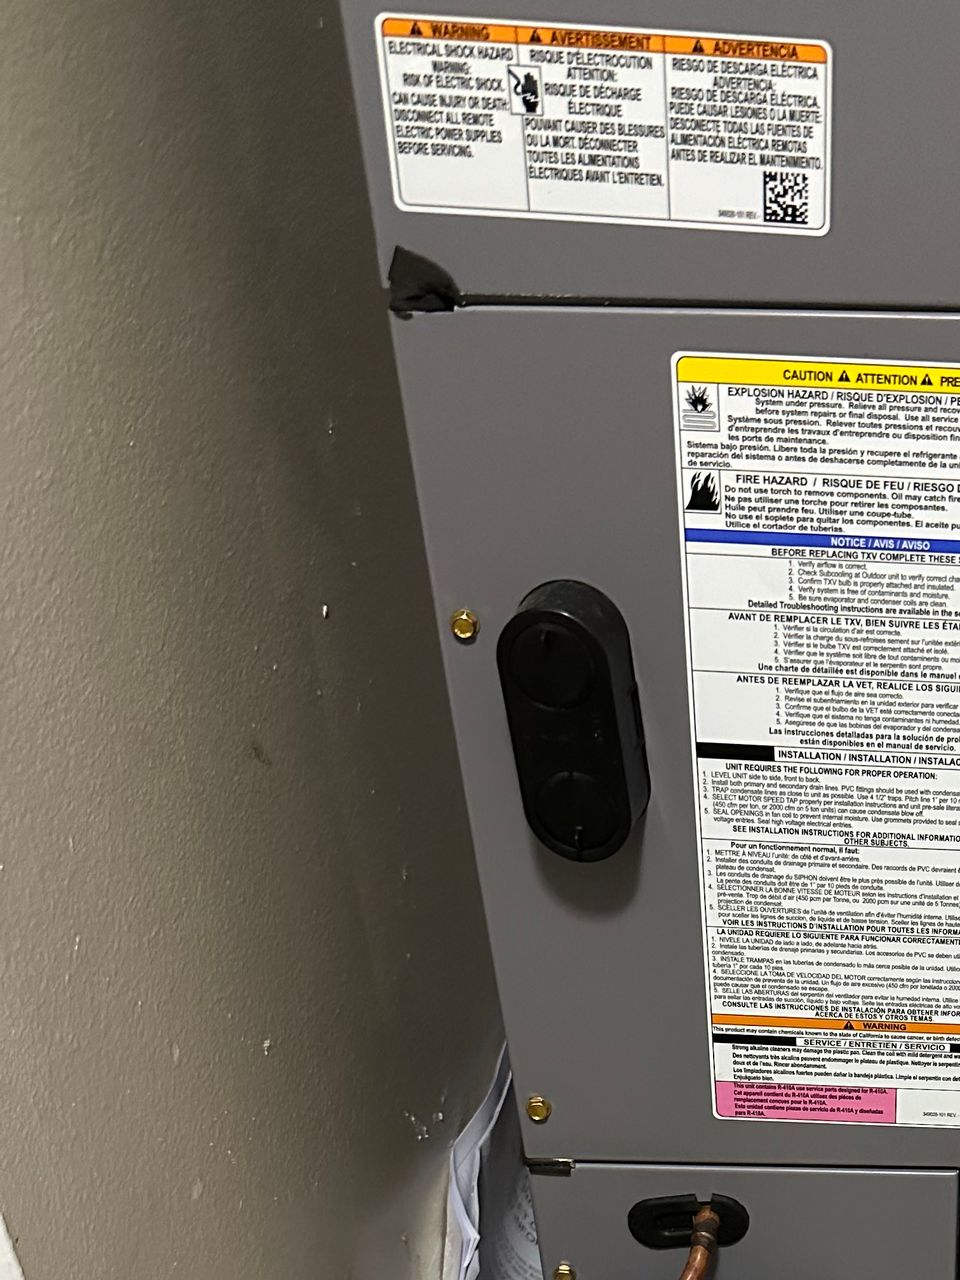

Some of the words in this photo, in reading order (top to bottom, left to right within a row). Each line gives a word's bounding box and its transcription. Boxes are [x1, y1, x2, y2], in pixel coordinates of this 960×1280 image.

[431, 23, 490, 40] WARNING
[550, 31, 649, 50] AVERTISSEMENT
[387, 40, 441, 56] ELECTRICAL
[444, 44, 475, 58] SHOCK
[477, 46, 513, 61] HAZARD
[529, 49, 564, 64] RISQUE
[566, 49, 652, 69] D'ÉLECTROCUTION
[713, 42, 797, 60] ADVERTENCIA
[566, 67, 617, 82] ATTENTION:
[672, 58, 704, 72] RIESGO
[706, 60, 718, 73] DE
[720, 61, 767, 76] DESCARGA
[770, 61, 817, 79] ELÉCTRICA
[402, 72, 421, 86] RISK
[422, 74, 433, 87] OF
[434, 74, 473, 89] ELECTRIC
[475, 77, 503, 91] SHOCK.
[712, 76, 776, 91] ADVERTENCIA:
[391, 91, 409, 104] CAN
[410, 93, 437, 106] CAUSE
[438, 94, 466, 108] INJURY
[468, 96, 480, 109] OR
[481, 97, 509, 111] DEATH:
[543, 83, 576, 97] RISQUE
[578, 85, 590, 98] DE
[592, 83, 641, 101] DÉCHARGE
[671, 87, 704, 100] RIESGO
[705, 89, 717, 101] DE
[719, 90, 767, 104] DESCARGA
[770, 91, 820, 108] ELÉCTRICA.
[393, 108, 443, 123] DISCONNECT
[445, 111, 459, 124] ALL
[461, 112, 494, 126] REMOTE
[568, 99, 622, 118] ÉLECTRIQUE
[668, 102, 694, 114] PUEDE
[696, 104, 728, 117] CAUSAR
[730, 106, 767, 119] LESIONES
[769, 108, 775, 120] O
[777, 109, 786, 120] LA
[788, 109, 822, 123] MUERTE:
[395, 125, 433, 139] ELECTRIC
[434, 128, 464, 141] POWER
[465, 130, 502, 144] SUPPLIES
[524, 117, 562, 131] POUVANT
[564, 120, 597, 133] CAUSER
[599, 122, 615, 134] DES
[617, 123, 665, 137] BLESSURES
[669, 117, 720, 132] DESCONECTE
[723, 120, 748, 134] TODAS
[750, 122, 764, 135] LAS
[766, 123, 801, 137] FUENTES
[803, 126, 813, 138] DE
[525, 134, 538, 146] OU
[539, 135, 550, 147] LA
[551, 135, 576, 148] MORT.
[577, 135, 638, 152] DÉCONNECTER
[670, 131, 725, 148] ALIMENTACIÓN
[727, 134, 769, 150] ELÉCTRICA
[771, 139, 806, 152] REMOTAS
[527, 150, 558, 163] TOUTES
[560, 152, 576, 164] LES
[577, 153, 639, 168] ALIMENTATIONS
[670, 148, 695, 161] ANTES
[697, 150, 707, 162] DE
[709, 151, 746, 164] REALIZAR
[748, 153, 756, 165] EL
[759, 154, 822, 169] MANTENIMIENTO.
[527, 164, 583, 181] ÉLECTRIQUES
[585, 170, 609, 182] AVANT
[612, 171, 664, 186] L'ENTRETIEN.
[782, 370, 832, 381] CAUTION
[855, 373, 917, 385] ATTENTION
[727, 387, 784, 398] EXPLOSION
[787, 390, 828, 400] HAZARD
[836, 392, 873, 403] RISQUE
[876, 394, 942, 405] D'EXPLOSION
[755, 398, 783, 408] System
[809, 402, 844, 410] pressure.
[848, 402, 876, 410] Relieve
[888, 406, 921, 414] pressure
[735, 474, 760, 484] FIRE
[763, 476, 807, 486] HAZARD
[822, 478, 862, 489] RISQUE
[865, 480, 880, 489] DE
[883, 481, 904, 490] FEU
[913, 482, 954, 492] RIESGO
[724, 485, 736, 493] Do
[770, 487, 791, 495] torch
[836, 490, 888, 501] components.
[891, 492, 903, 500] Oil
[904, 494, 921, 502] may
[831, 538, 865, 547] NOTICE
[873, 540, 894, 548] AVIS
[902, 541, 929, 550] AVISO
[771, 548, 806, 557] BEFORE
[808, 549, 858, 559] REPLACING
[861, 552, 876, 560] TXV
[879, 552, 925, 562] COMPLETE
[929, 554, 956, 563] THESE
[747, 600, 777, 608] Detailed
[780, 602, 838, 613] Troubleshooting
[840, 604, 883, 613] instructions
[778, 750, 841, 761] INSTALLATION
[848, 753, 911, 764] INSTALLATION
[862, 1022, 907, 1030] WARNING
